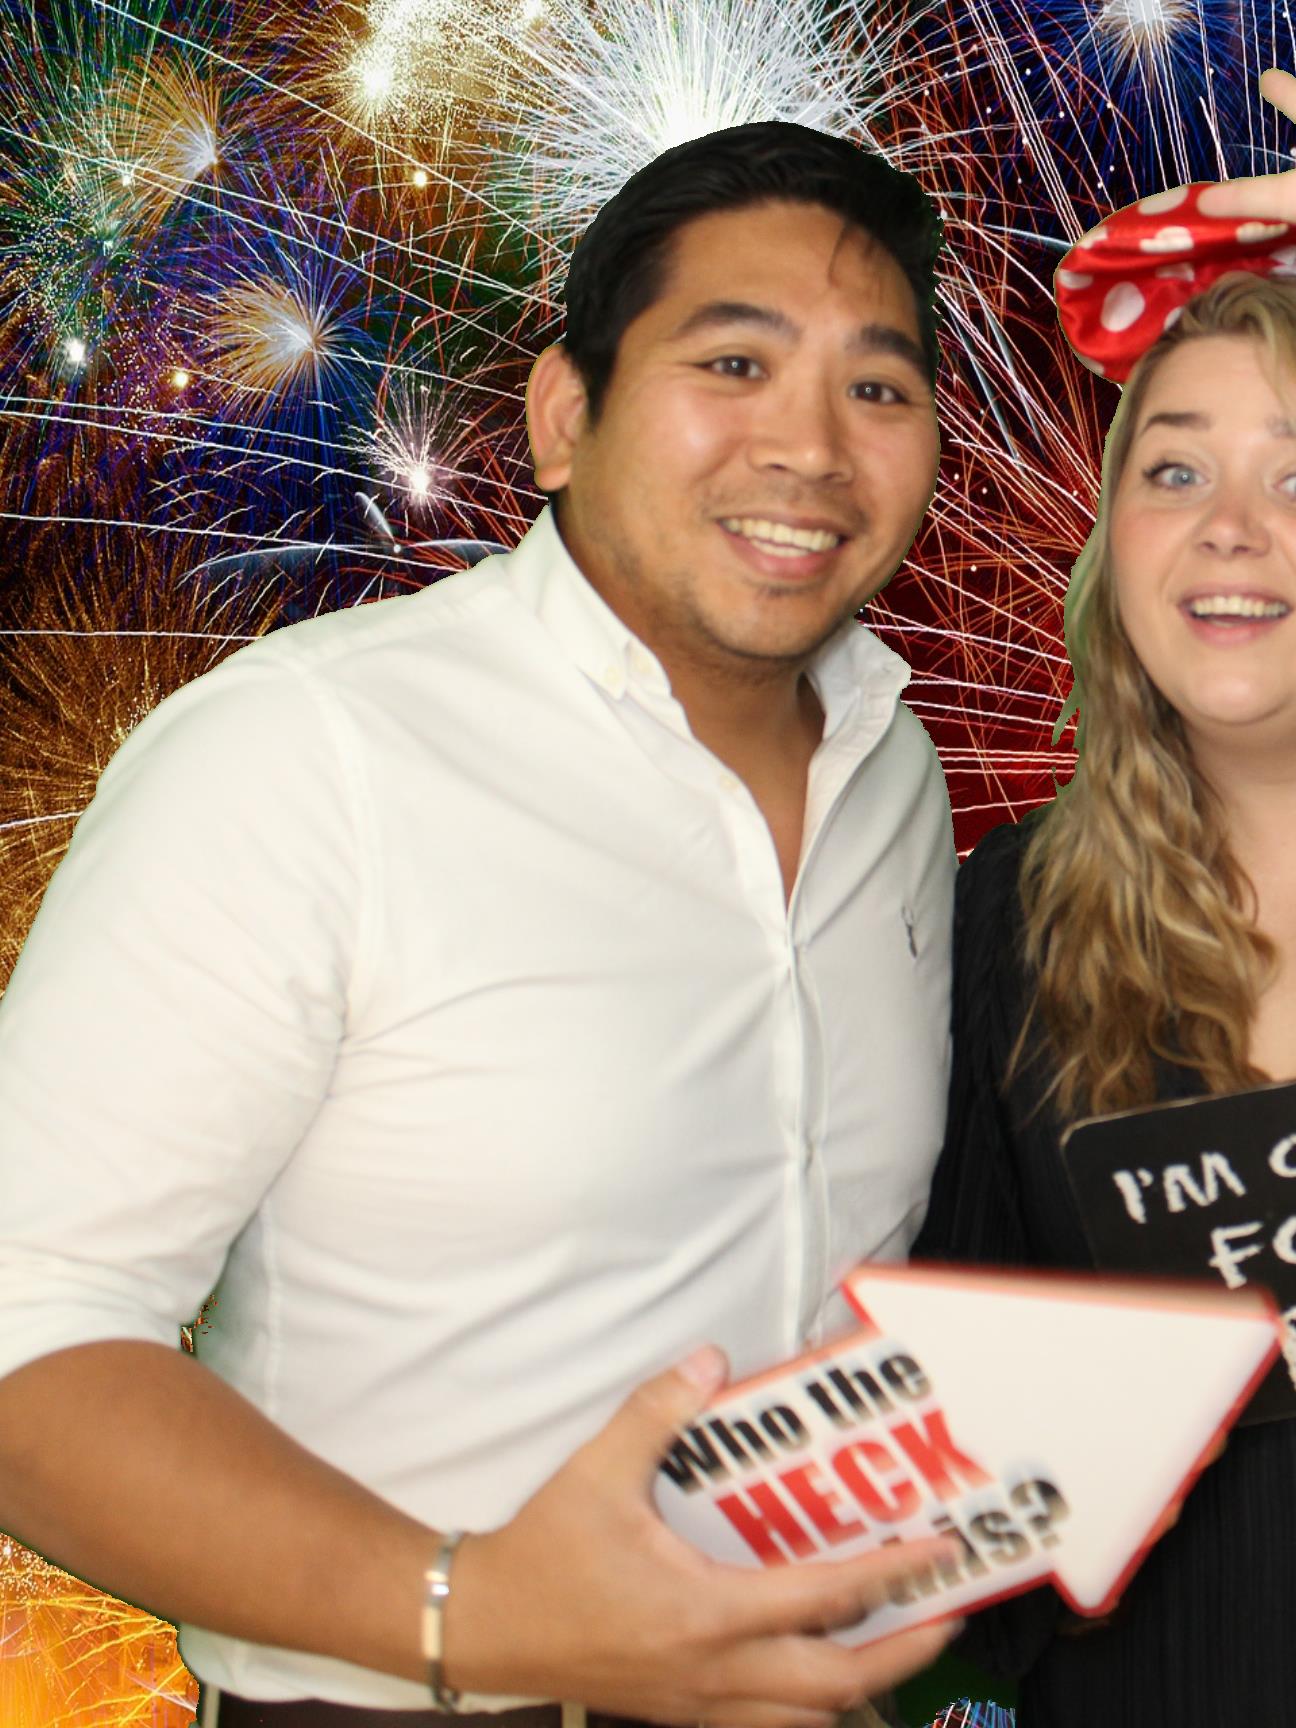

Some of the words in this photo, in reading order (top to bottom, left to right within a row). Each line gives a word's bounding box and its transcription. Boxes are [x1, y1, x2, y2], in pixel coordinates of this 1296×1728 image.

[1113, 1151, 1246, 1224] I'M
[658, 1404, 812, 1496] Who
[806, 1353, 931, 1430] the
[714, 1408, 998, 1569] HECK
